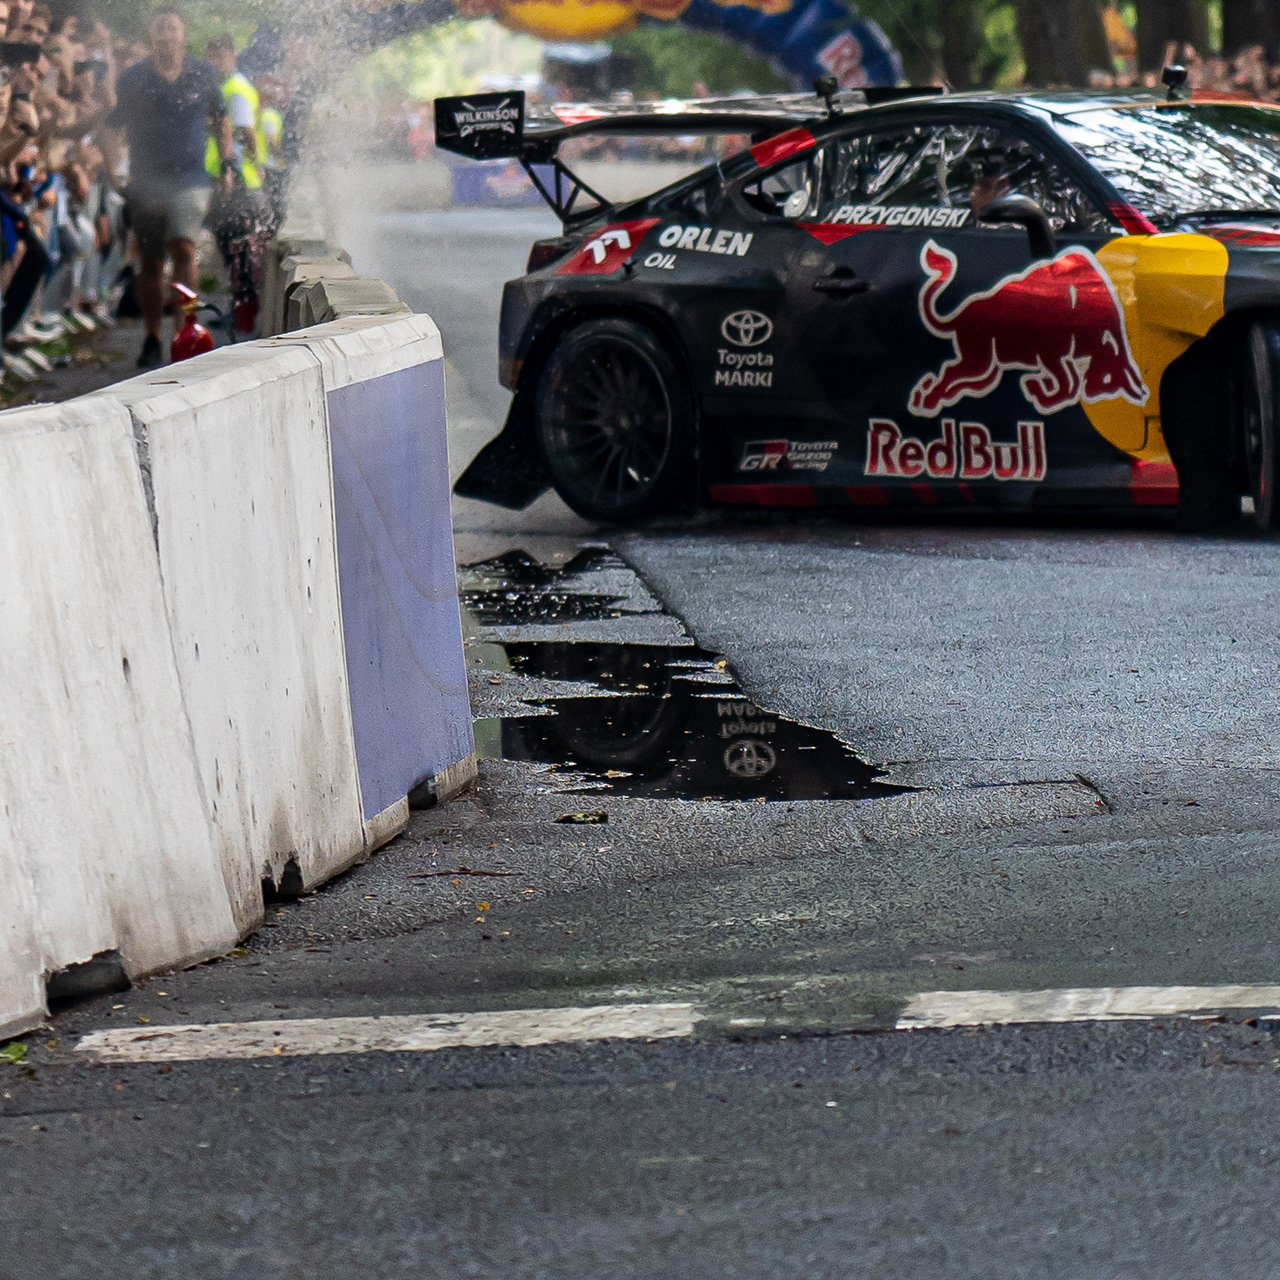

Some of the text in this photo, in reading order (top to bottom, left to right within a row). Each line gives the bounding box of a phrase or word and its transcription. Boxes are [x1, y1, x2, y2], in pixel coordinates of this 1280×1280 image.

[454, 107, 519, 127] WILKINSON
[658, 225, 754, 257] ORLEN
[644, 252, 678, 270] OIL
[717, 349, 775, 370] Toyota
[714, 370, 773, 388] MARKI
[864, 418, 1047, 481] Red Bull
[739, 453, 782, 471] GR
